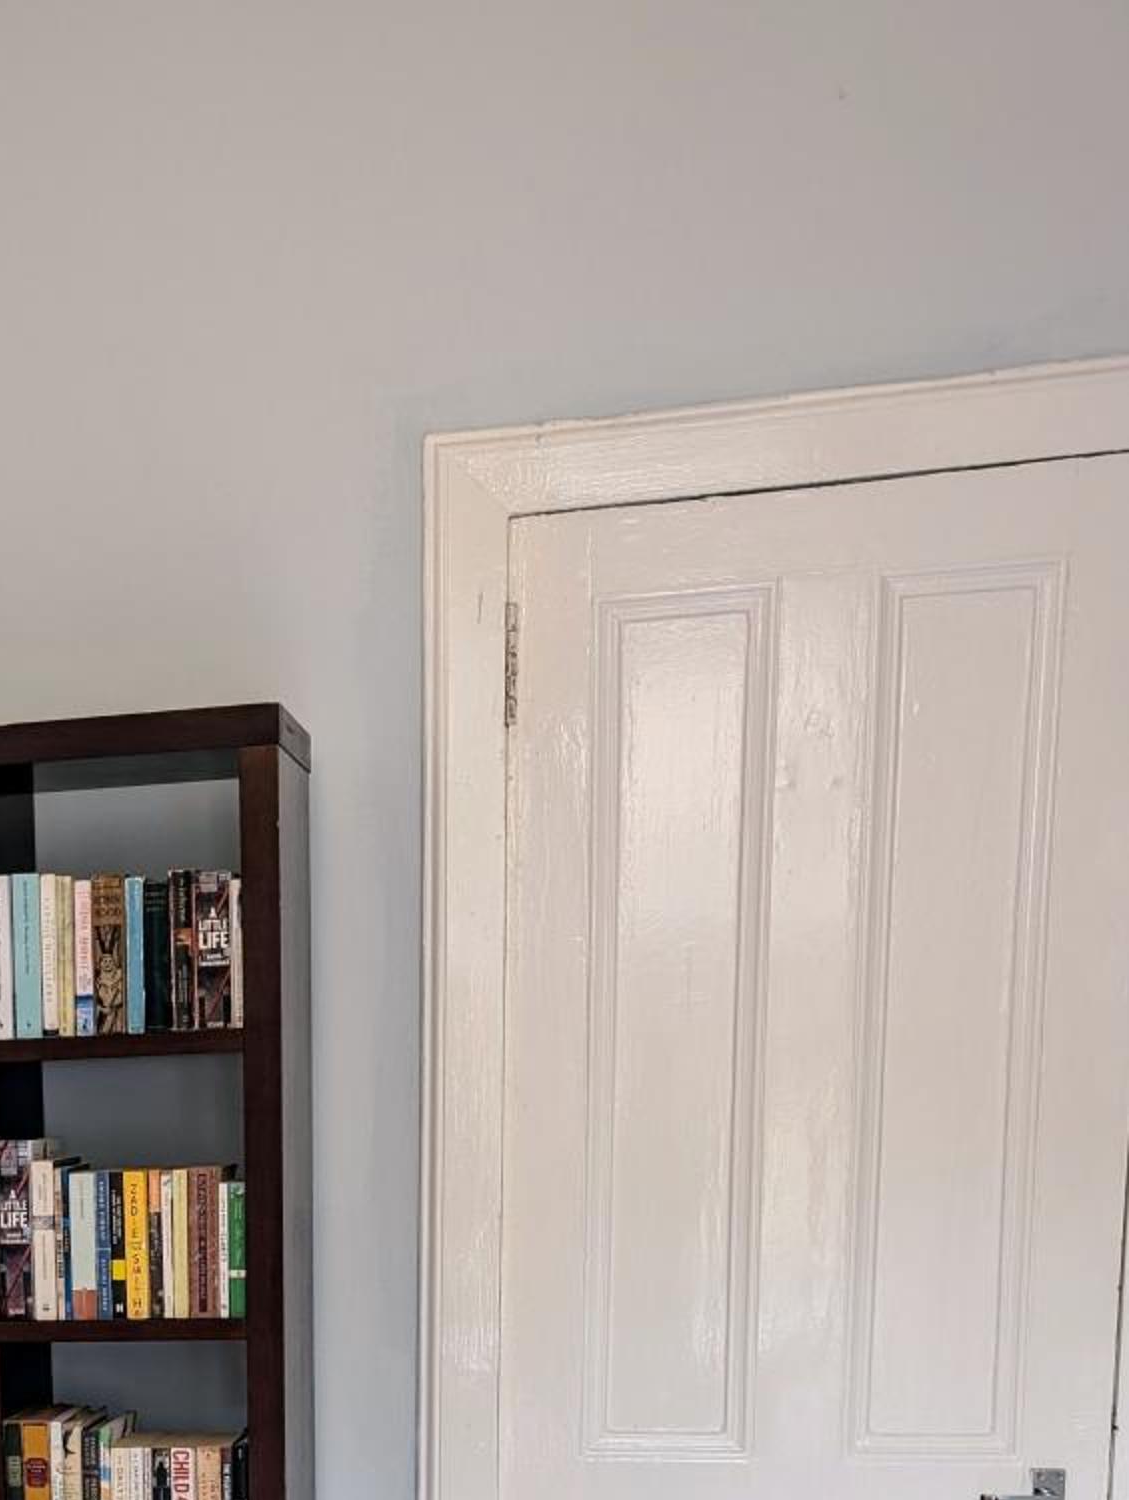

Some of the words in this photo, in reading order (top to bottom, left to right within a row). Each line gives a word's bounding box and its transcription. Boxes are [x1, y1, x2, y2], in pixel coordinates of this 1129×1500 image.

[209, 907, 216, 917] A
[198, 919, 229, 932] LITTLE
[198, 931, 229, 949] LIFE
[9, 1190, 16, 1200] A
[0, 1200, 28, 1211] LITTLE
[0, 1211, 29, 1228] LIFE
[173, 1450, 190, 1492] CHILD
